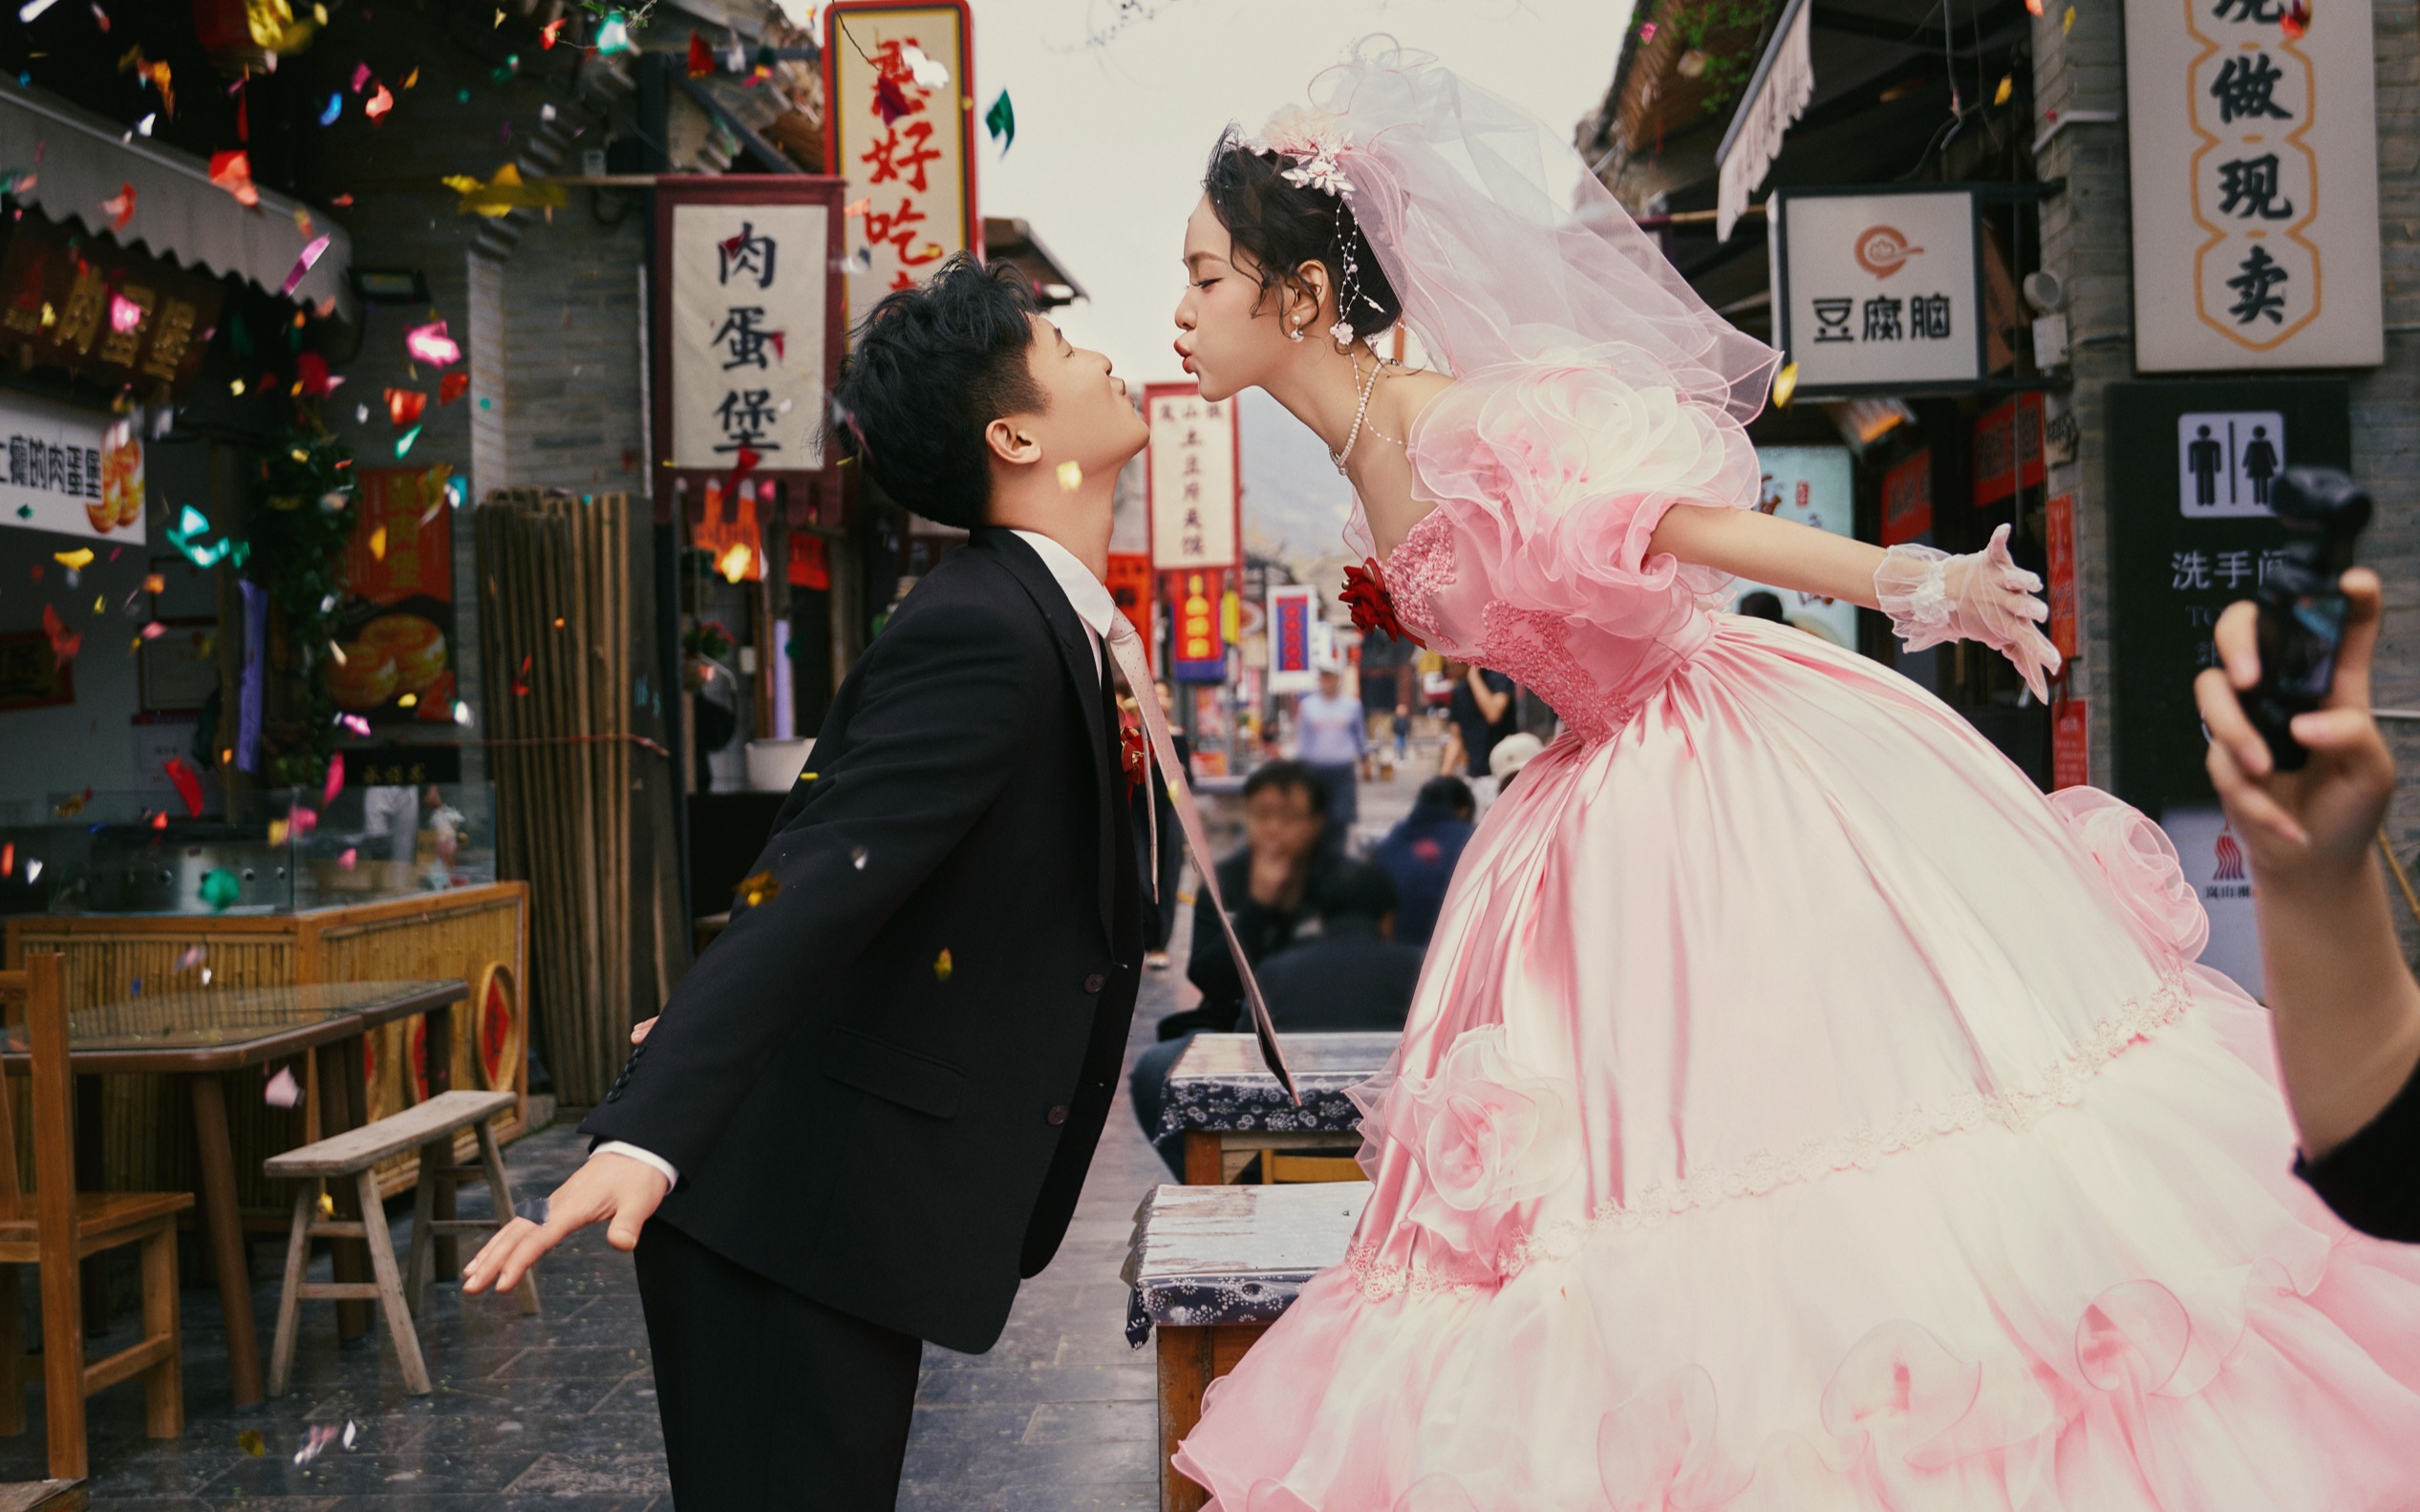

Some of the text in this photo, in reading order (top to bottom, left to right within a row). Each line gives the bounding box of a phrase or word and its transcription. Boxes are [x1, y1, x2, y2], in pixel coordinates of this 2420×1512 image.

[860, 37, 944, 292] 好吃
[713, 222, 779, 452] 肉蛋堡
[1811, 293, 1953, 345] 豆腐脑
